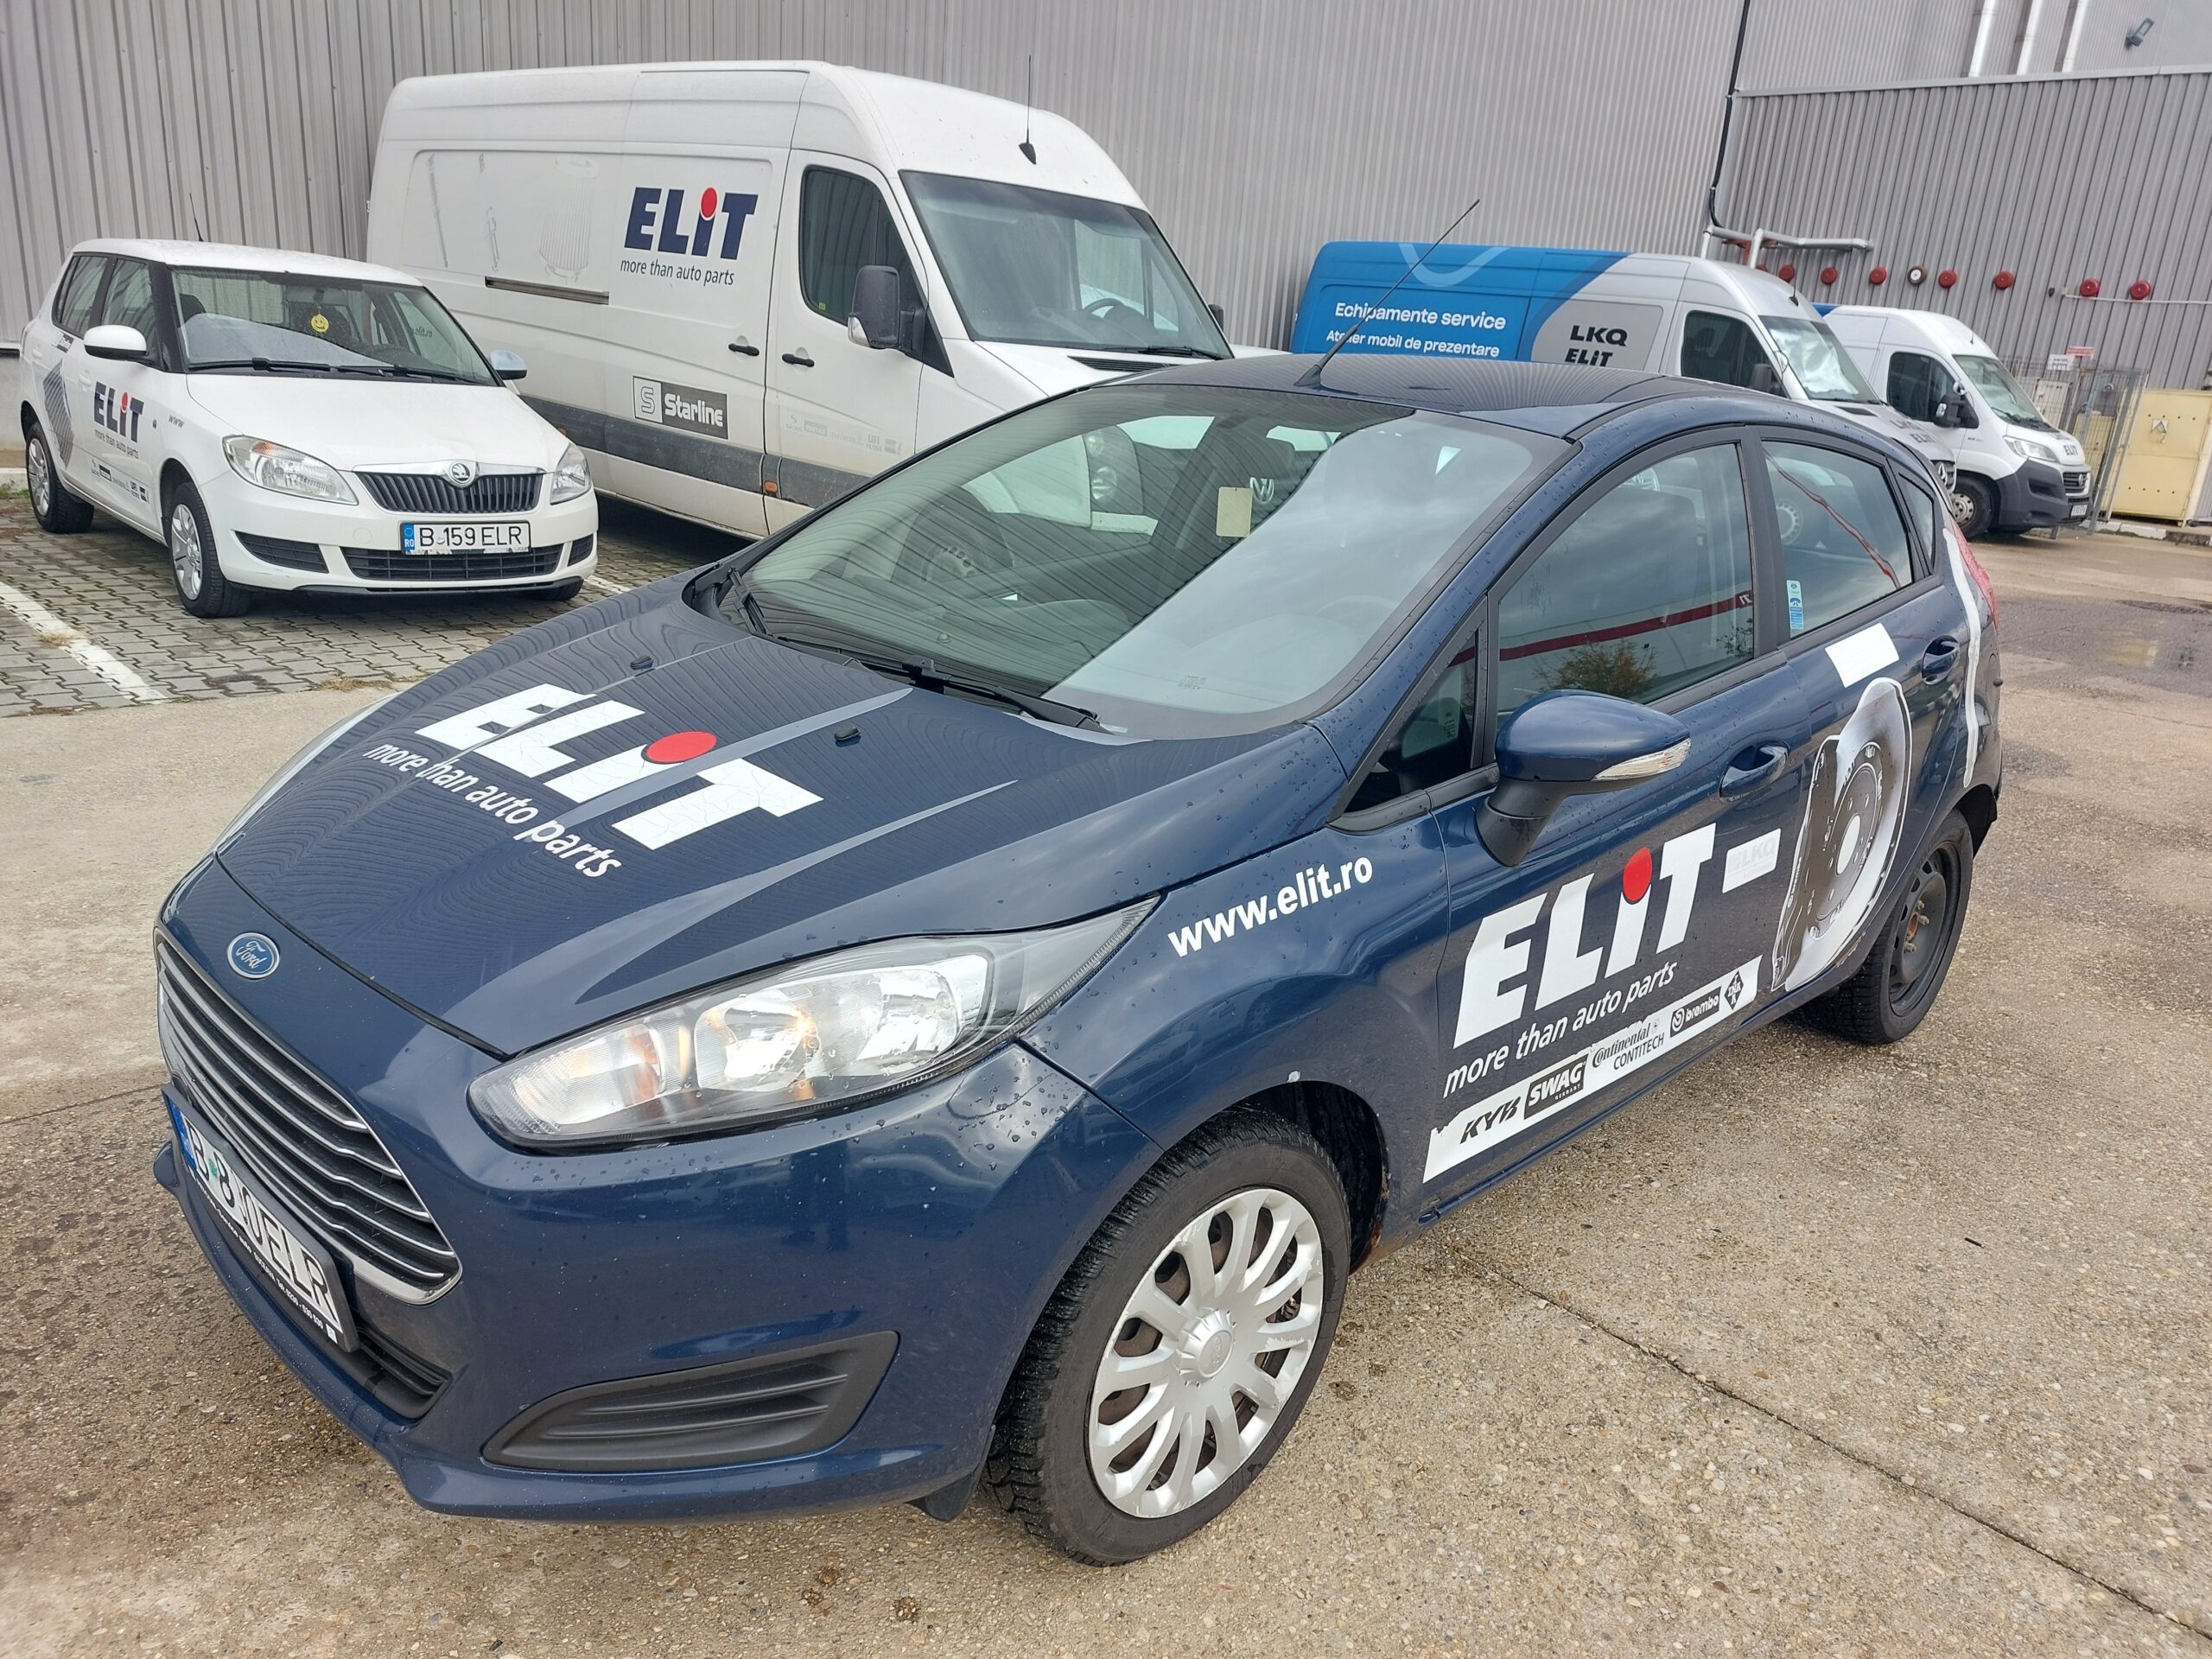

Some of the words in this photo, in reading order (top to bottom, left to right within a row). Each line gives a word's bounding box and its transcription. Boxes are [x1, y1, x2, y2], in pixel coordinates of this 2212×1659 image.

[620, 259, 646, 274] more
[650, 259, 673, 277] than
[677, 265, 701, 281] auto
[703, 270, 734, 287] parts
[1335, 302, 1438, 324] Echipamente
[1441, 311, 1506, 330] service
[1368, 334, 1402, 348] mobil
[1405, 337, 1421, 350] de
[1424, 340, 1499, 357] prezentare
[1570, 325, 1627, 346] LKQ
[664, 392, 723, 427] Starline
[404, 539, 415, 548] RO
[419, 528, 434, 546] B
[443, 527, 475, 546] 159
[481, 526, 522, 546] ELR
[362, 744, 429, 772] more
[416, 759, 479, 792] than
[465, 785, 539, 824] auto
[512, 820, 621, 878] parts
[1167, 857, 1373, 957] www.elit.ro
[1686, 995, 1719, 1022] brembo
[1443, 1045, 1509, 1098] more
[1516, 1016, 1567, 1060] than
[1573, 990, 1622, 1031] auto
[1622, 961, 1677, 1013] parts
[1592, 1022, 1651, 1068] Continental
[1614, 1033, 1664, 1071] CONTITECH
[1529, 1062, 1583, 1107] SWAG
[1460, 1096, 1521, 1144] KYB
